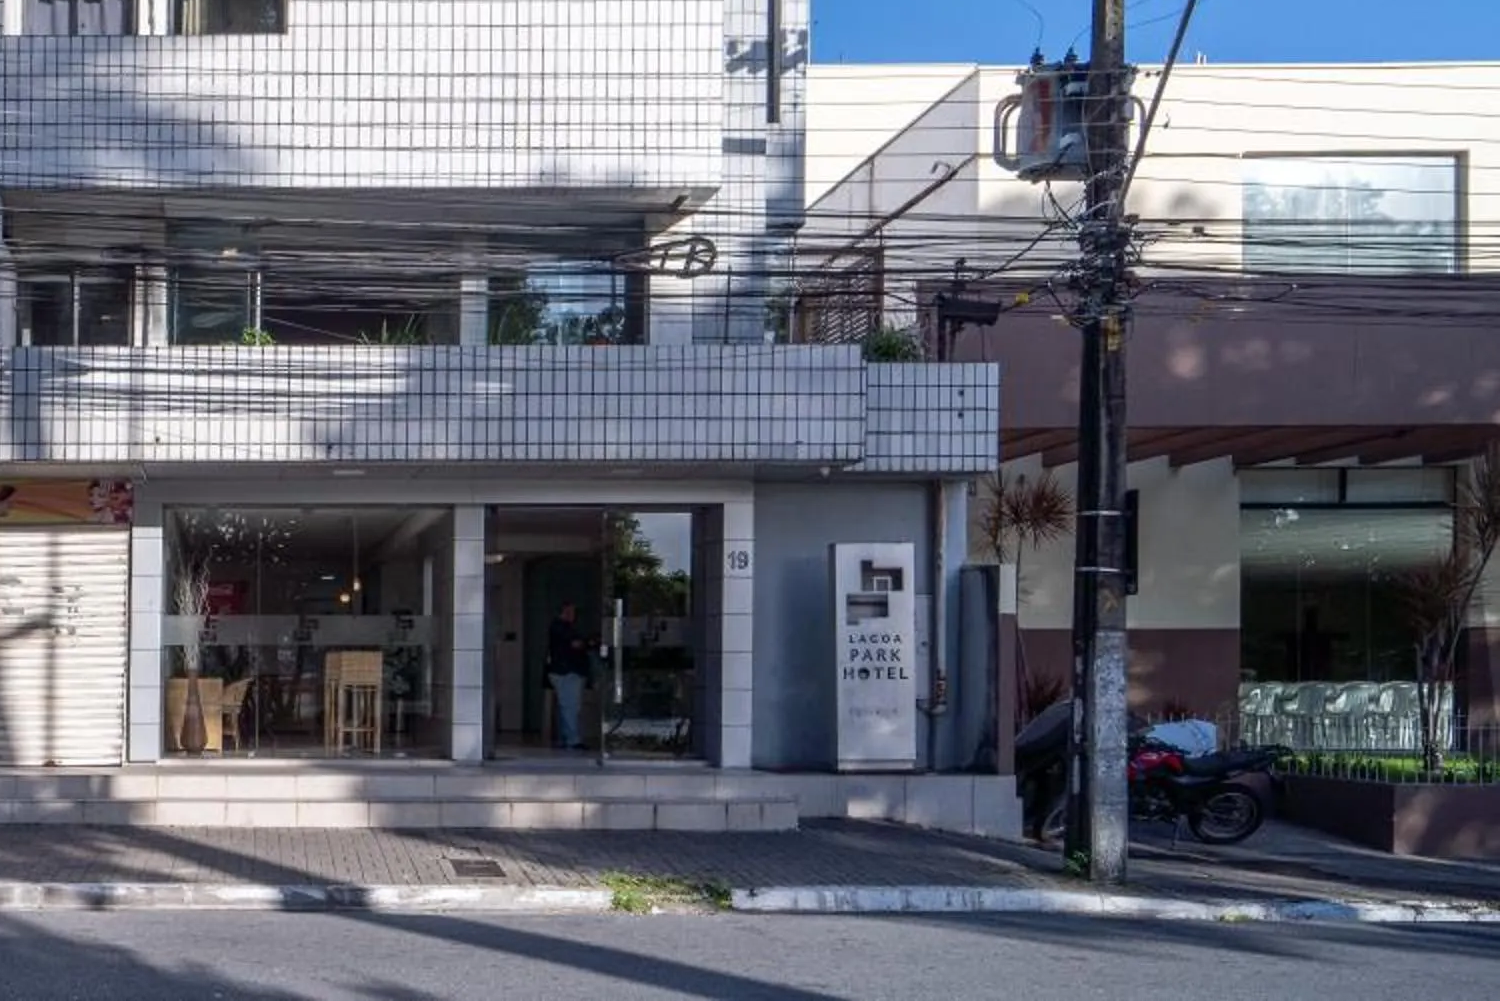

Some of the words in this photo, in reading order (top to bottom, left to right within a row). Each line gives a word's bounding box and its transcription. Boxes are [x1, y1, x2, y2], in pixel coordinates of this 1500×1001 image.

[727, 550, 749, 570] 19
[848, 634, 902, 644] LAGOA
[850, 648, 901, 662] PARK
[843, 666, 909, 680] HOTEL
